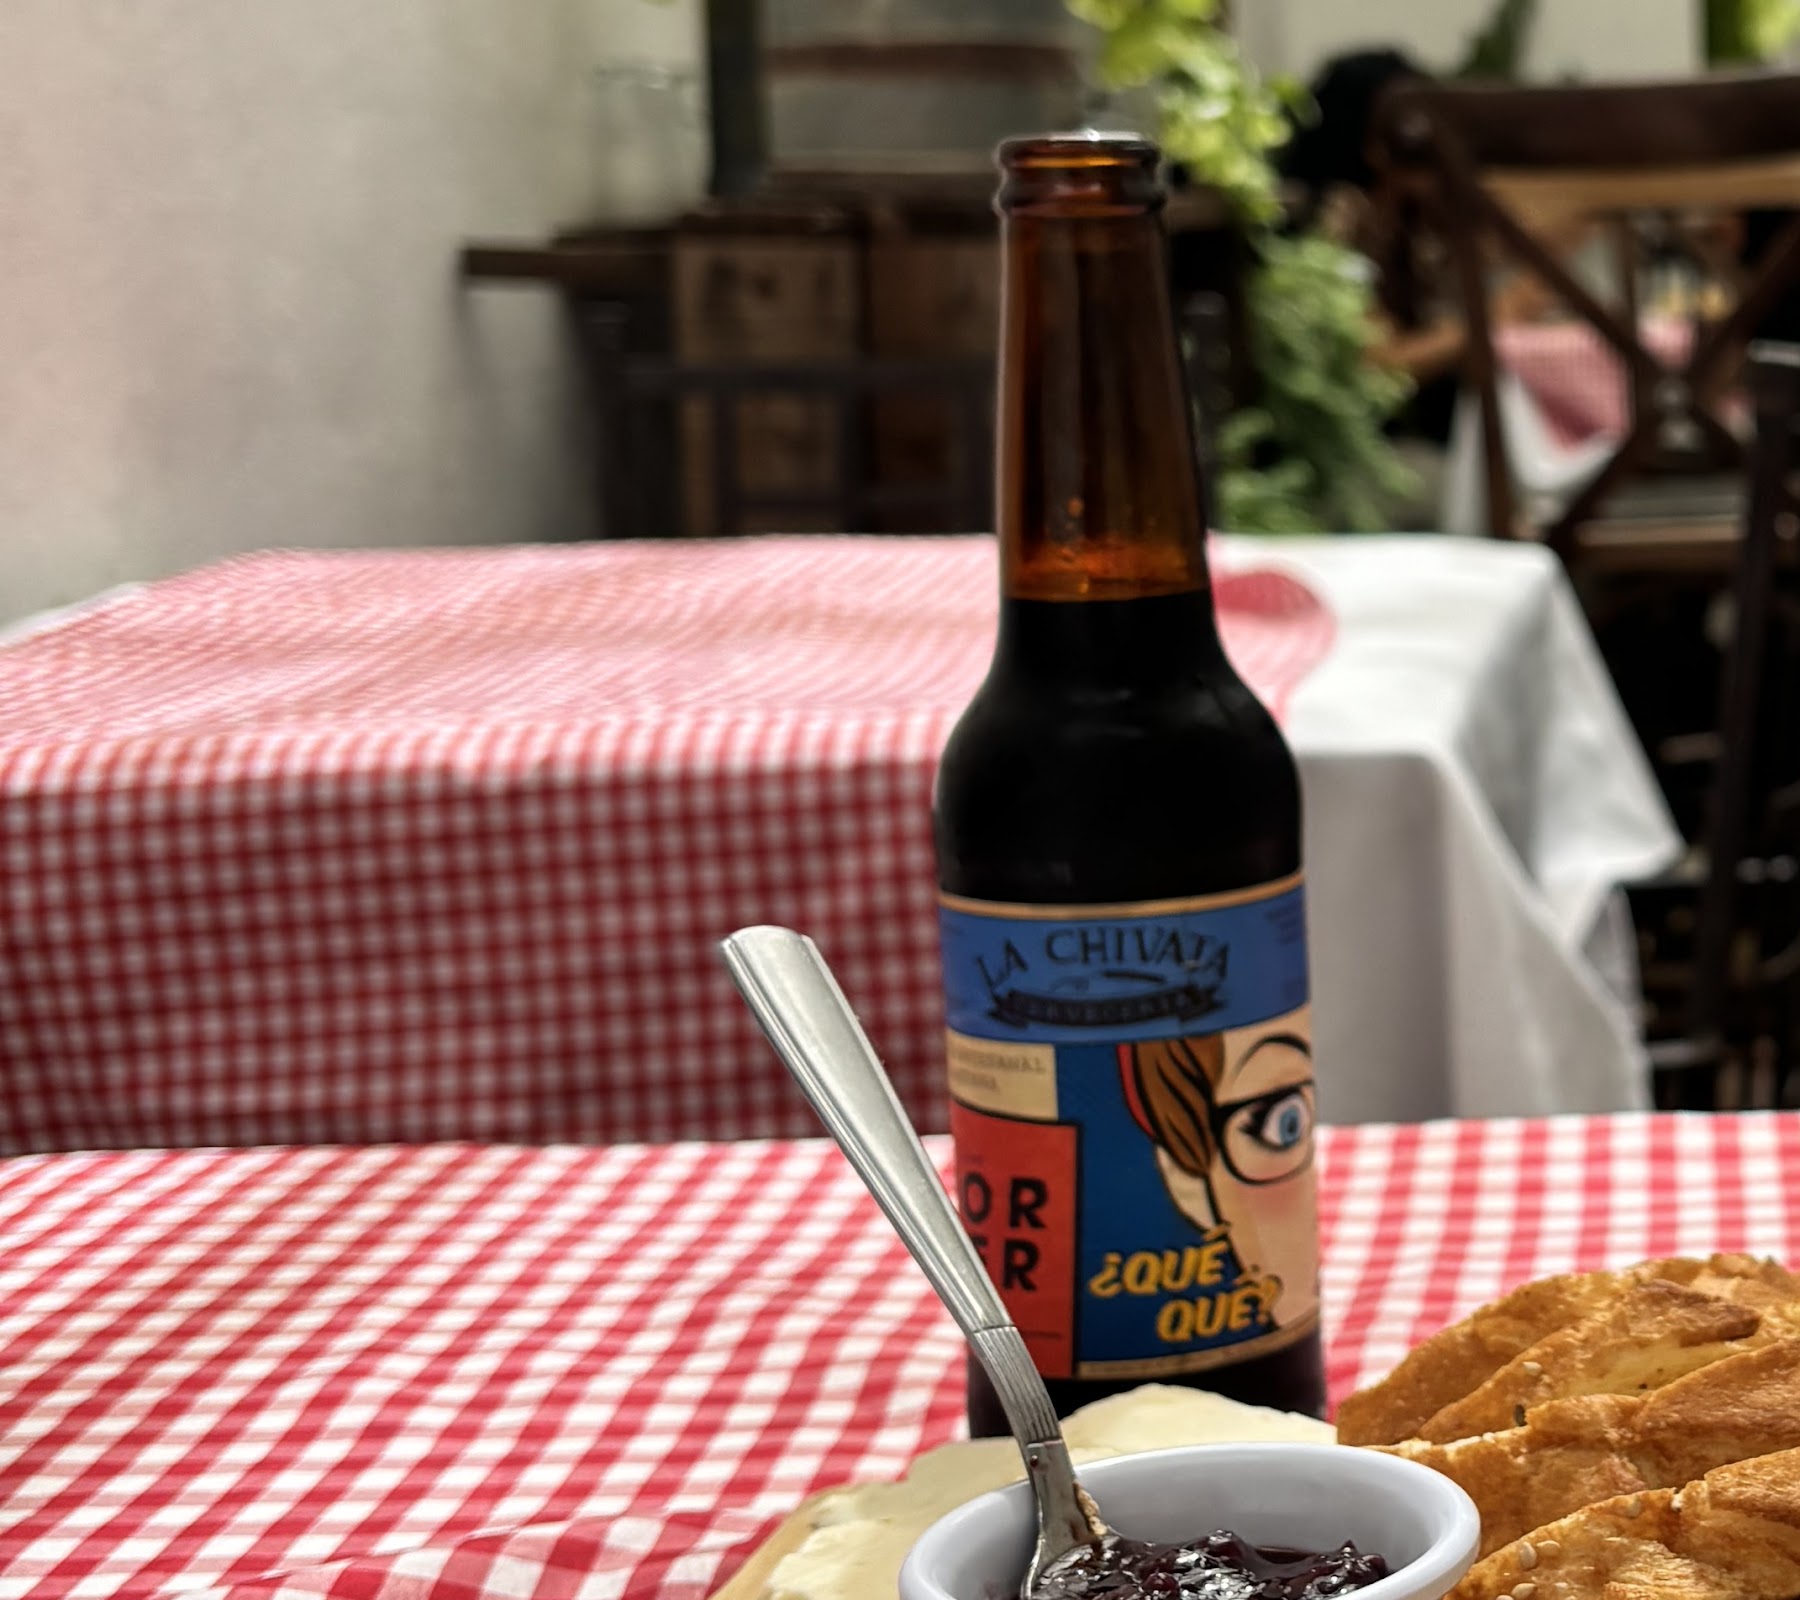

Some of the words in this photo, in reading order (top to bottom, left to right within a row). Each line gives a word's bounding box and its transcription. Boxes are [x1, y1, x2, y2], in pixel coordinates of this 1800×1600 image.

[975, 938, 1028, 995] LA
[1044, 926, 1230, 982] CHIVATA
[1088, 1222, 1231, 1298] ¿QUÉ
